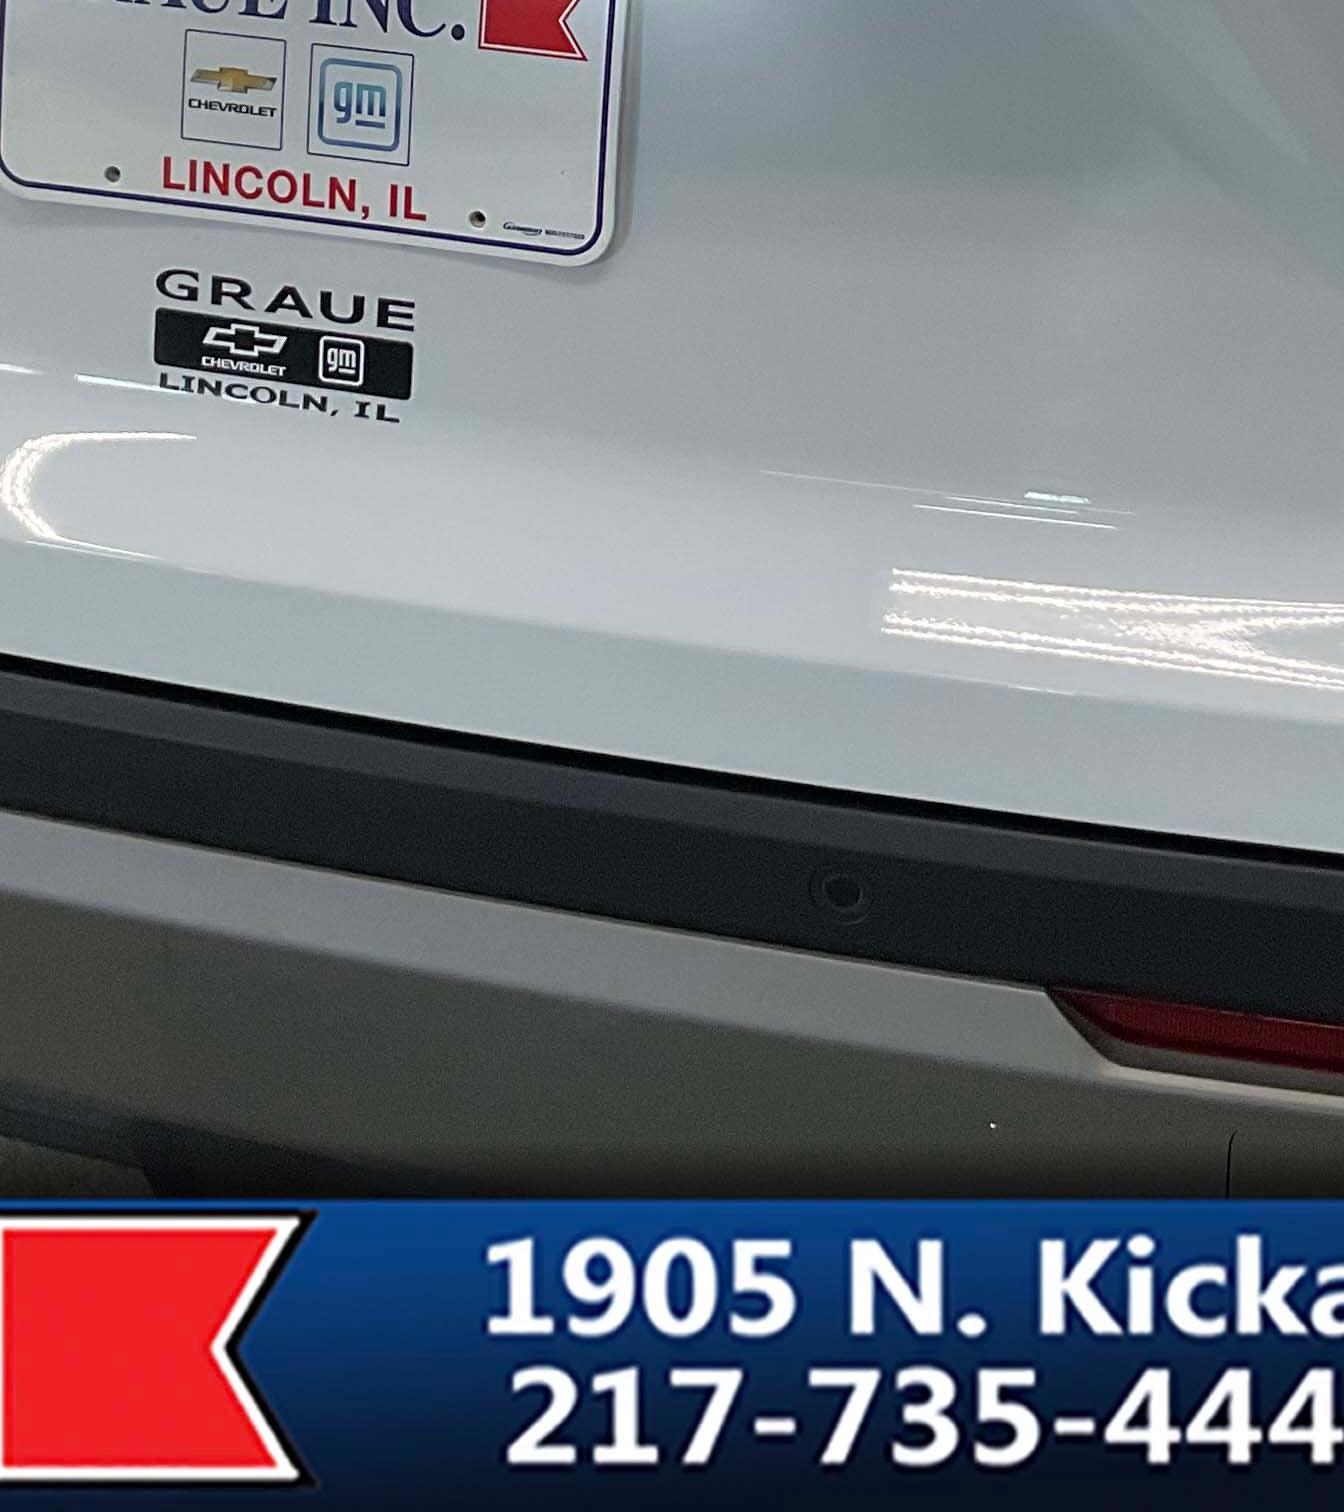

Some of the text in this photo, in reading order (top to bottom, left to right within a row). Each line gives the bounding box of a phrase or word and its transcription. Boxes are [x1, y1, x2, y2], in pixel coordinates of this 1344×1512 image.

[187, 97, 278, 118] CHEVROLET
[333, 80, 388, 130] gm
[161, 156, 427, 222] LINCOLN, IL
[154, 267, 416, 333] GRAUE
[201, 356, 287, 377] CHEVROLET
[326, 347, 357, 375] gm
[158, 372, 401, 424] LINCOLN, IL
